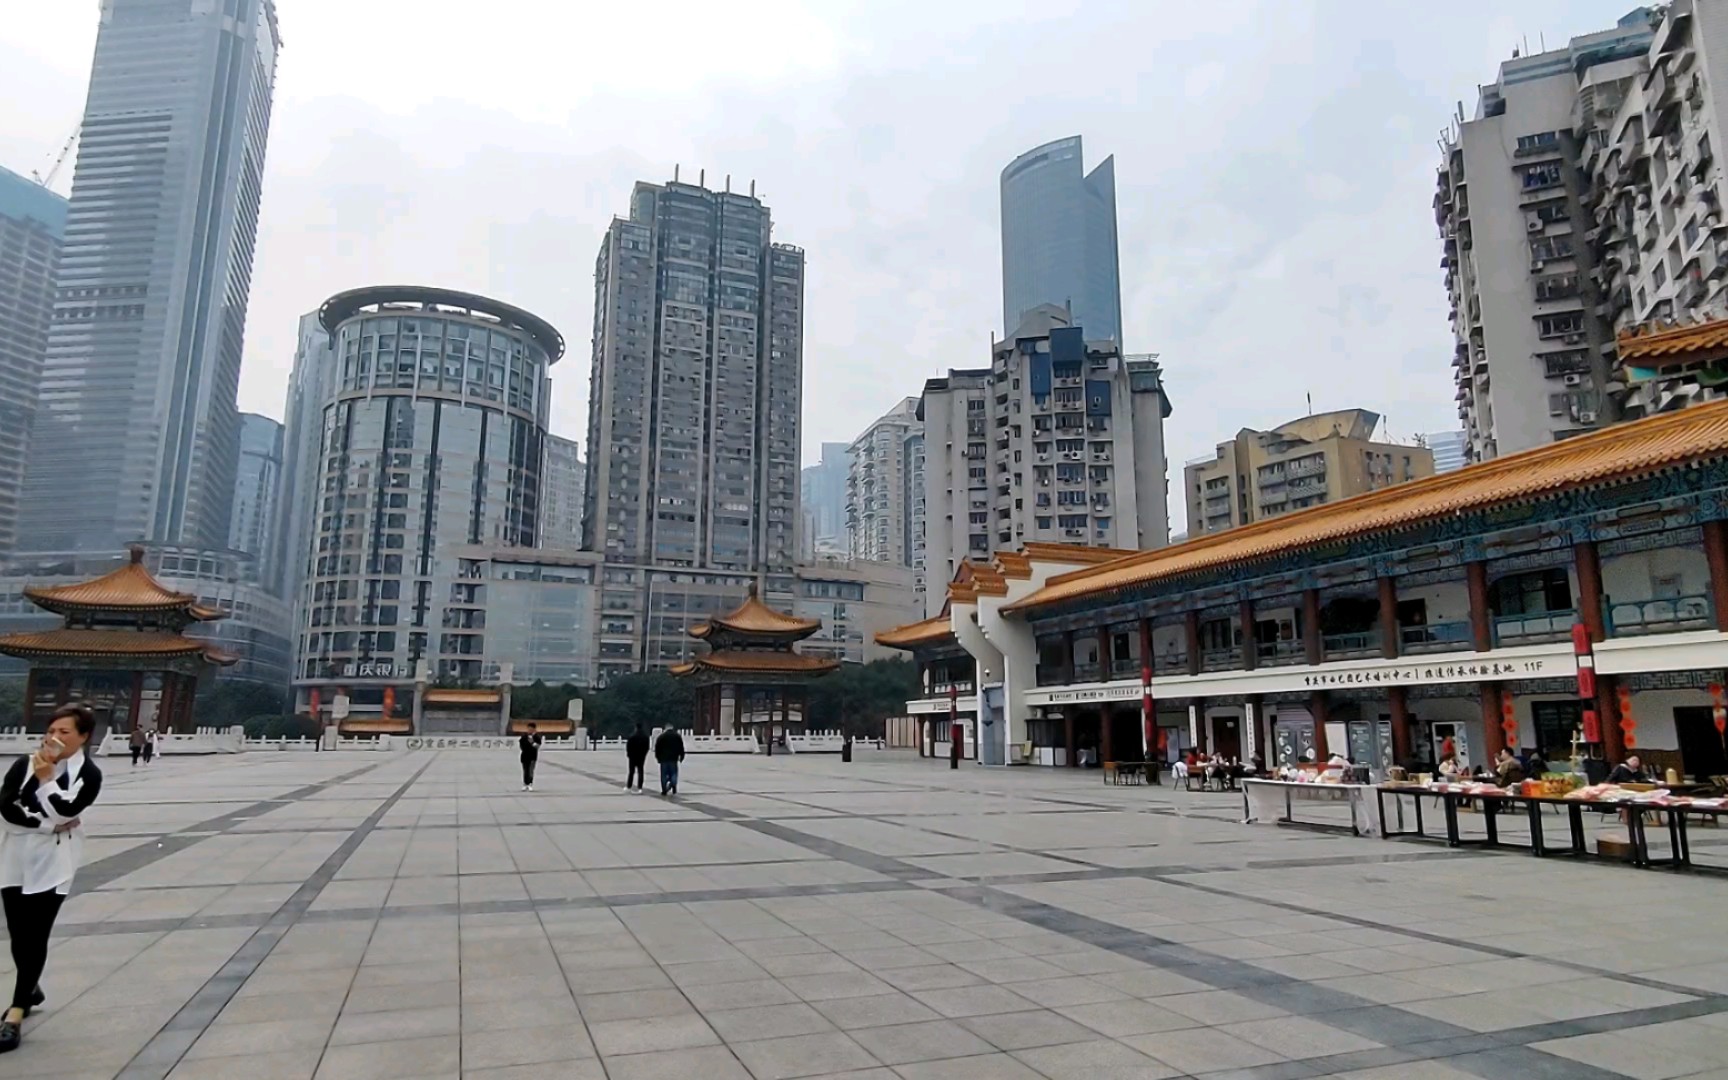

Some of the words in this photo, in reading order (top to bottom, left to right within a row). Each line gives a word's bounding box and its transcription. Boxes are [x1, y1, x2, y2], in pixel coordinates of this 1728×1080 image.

[343, 663, 408, 677] 重庆银行
[1524, 661, 1543, 671] 11F
